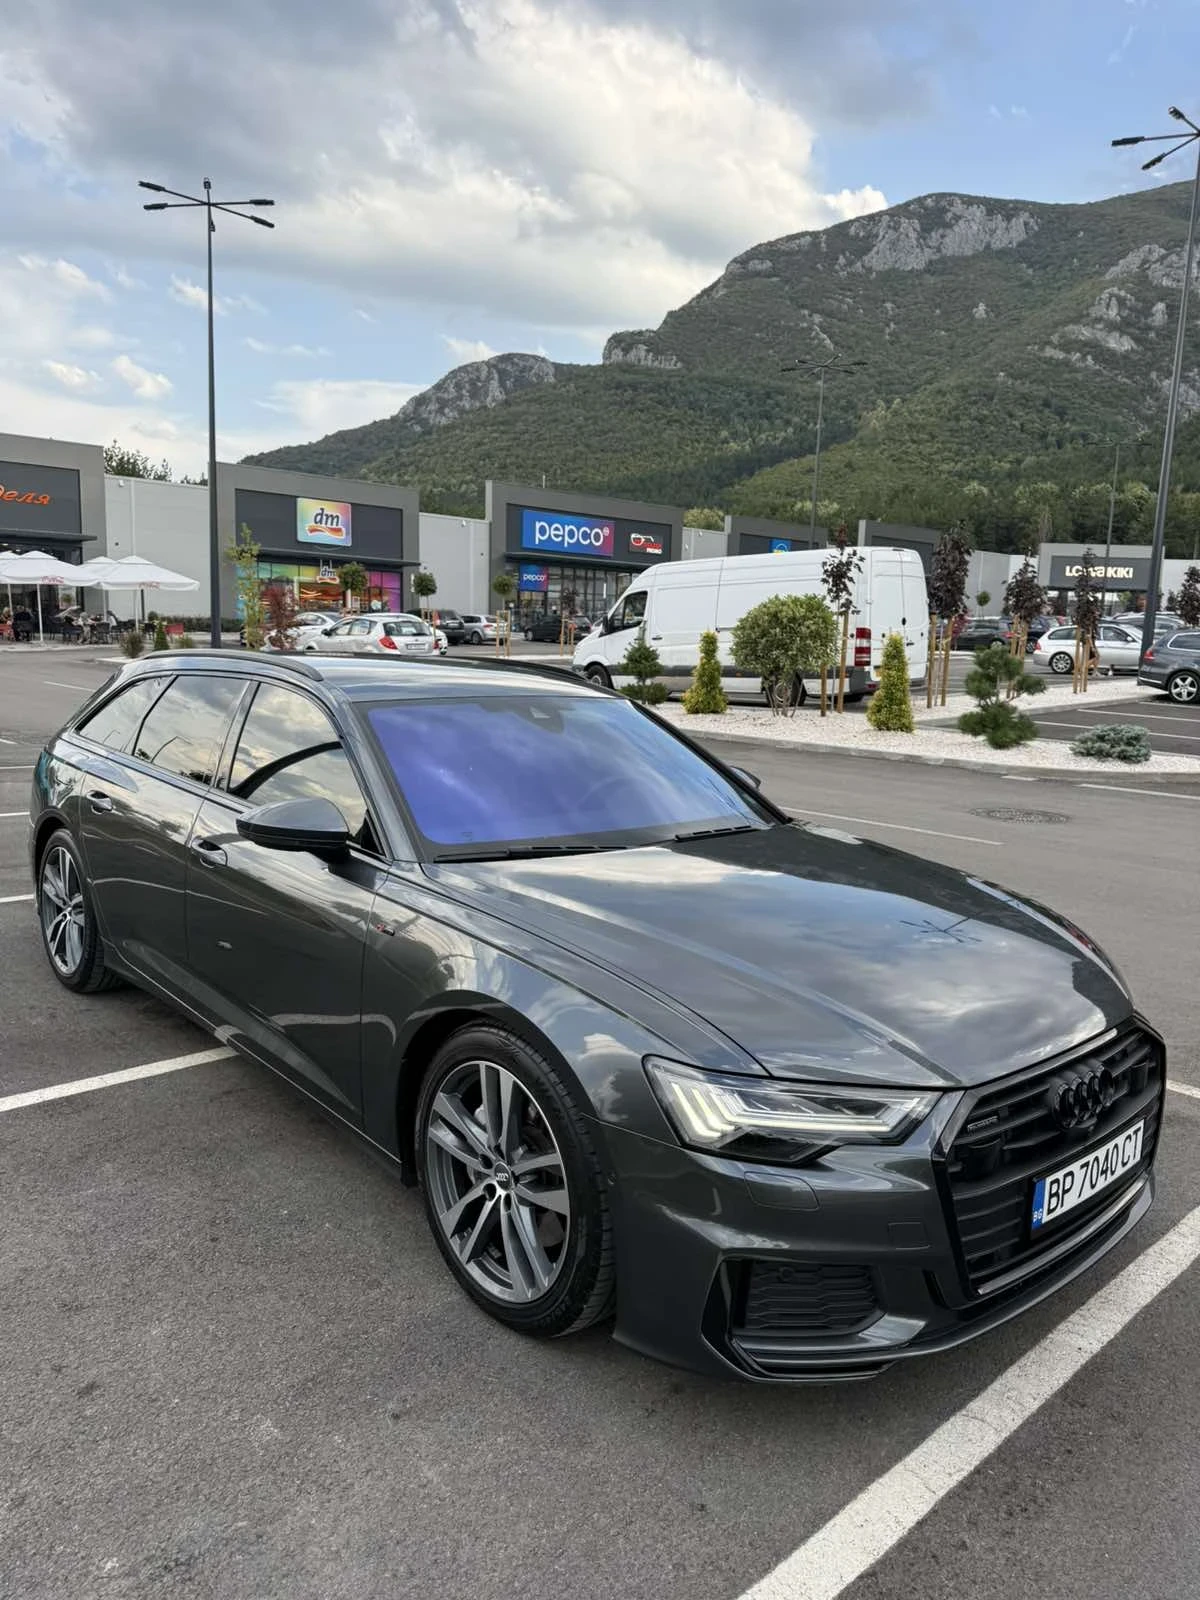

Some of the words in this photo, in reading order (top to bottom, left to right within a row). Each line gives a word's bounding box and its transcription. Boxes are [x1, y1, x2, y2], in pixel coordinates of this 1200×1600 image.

[314, 507, 341, 527] dm
[535, 520, 604, 548] pepco
[320, 567, 337, 578] dm
[523, 573, 546, 582] pepco
[1047, 1170, 1075, 1217] BP
[1077, 1142, 1119, 1199] 7040
[1121, 1126, 1142, 1168] CT
